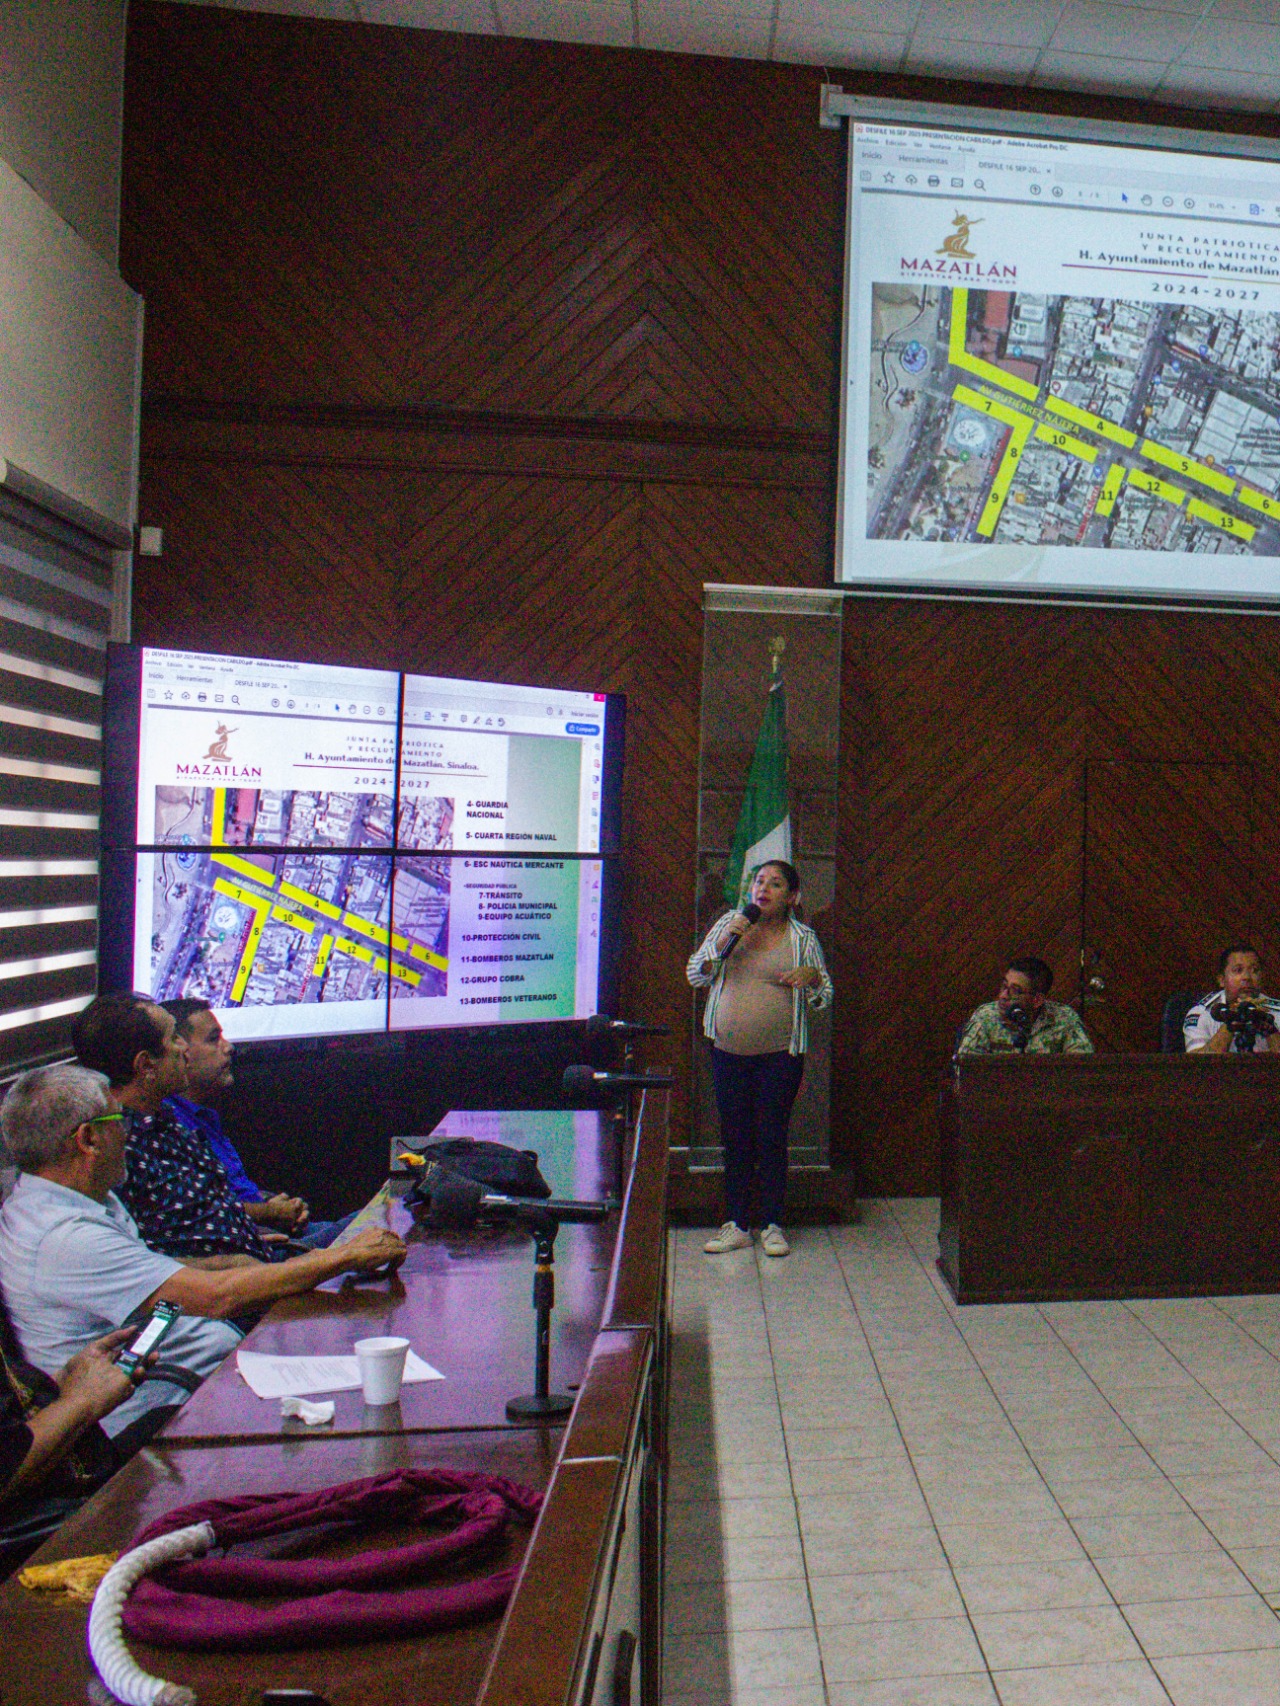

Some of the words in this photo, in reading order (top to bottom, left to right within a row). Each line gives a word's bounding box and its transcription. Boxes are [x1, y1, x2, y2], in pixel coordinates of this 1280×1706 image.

[861, 151, 882, 160] Inicio
[899, 154, 949, 166] Herramientas
[978, 161, 1004, 171] DESFILE
[1015, 164, 1026, 173] SEP
[1142, 243, 1149, 251] Y
[1158, 244, 1278, 263] RECLUTAMIENTO
[1079, 250, 1093, 260] H.
[1098, 252, 1195, 269] Ayuntamiento
[1198, 260, 1215, 270] de
[901, 257, 1017, 278] MAZATLÁN
[1152, 282, 1261, 300] 2024-2027
[985, 401, 992, 411] 7
[1096, 420, 1104, 431] 4
[1052, 435, 1066, 445] 10
[1010, 447, 1018, 458] 8
[1181, 461, 1188, 472] 5
[1147, 481, 1160, 492] 12
[992, 492, 998, 503] 9
[1101, 491, 1113, 500] 11
[1263, 499, 1270, 509] 6
[1221, 517, 1234, 528] 13
[304, 752, 314, 760] H.
[318, 753, 384, 764] Ayuntamiento
[176, 763, 261, 777] MAZATLÁN
[466, 811, 504, 819] NACIONAL
[505, 832, 533, 840] REGIÓN
[490, 860, 523, 868] NAÚTICA
[525, 861, 564, 869] MERCANTE
[487, 902, 517, 910] POLICIA
[518, 902, 557, 910] MUNICIPAL
[284, 914, 293, 922] 10
[515, 912, 552, 920] ACUÁTICO
[462, 933, 520, 941] 10-PROTECCIÓN
[522, 933, 541, 941] CIVIL
[347, 946, 356, 954] 12
[316, 957, 325, 965] 11
[461, 954, 513, 962] 11-BOMBEROS
[515, 953, 554, 961] MAZATLÁN
[398, 969, 407, 977] 13
[460, 995, 512, 1004] 13-BOMBEROS
[514, 994, 557, 1002] VETERANOS
